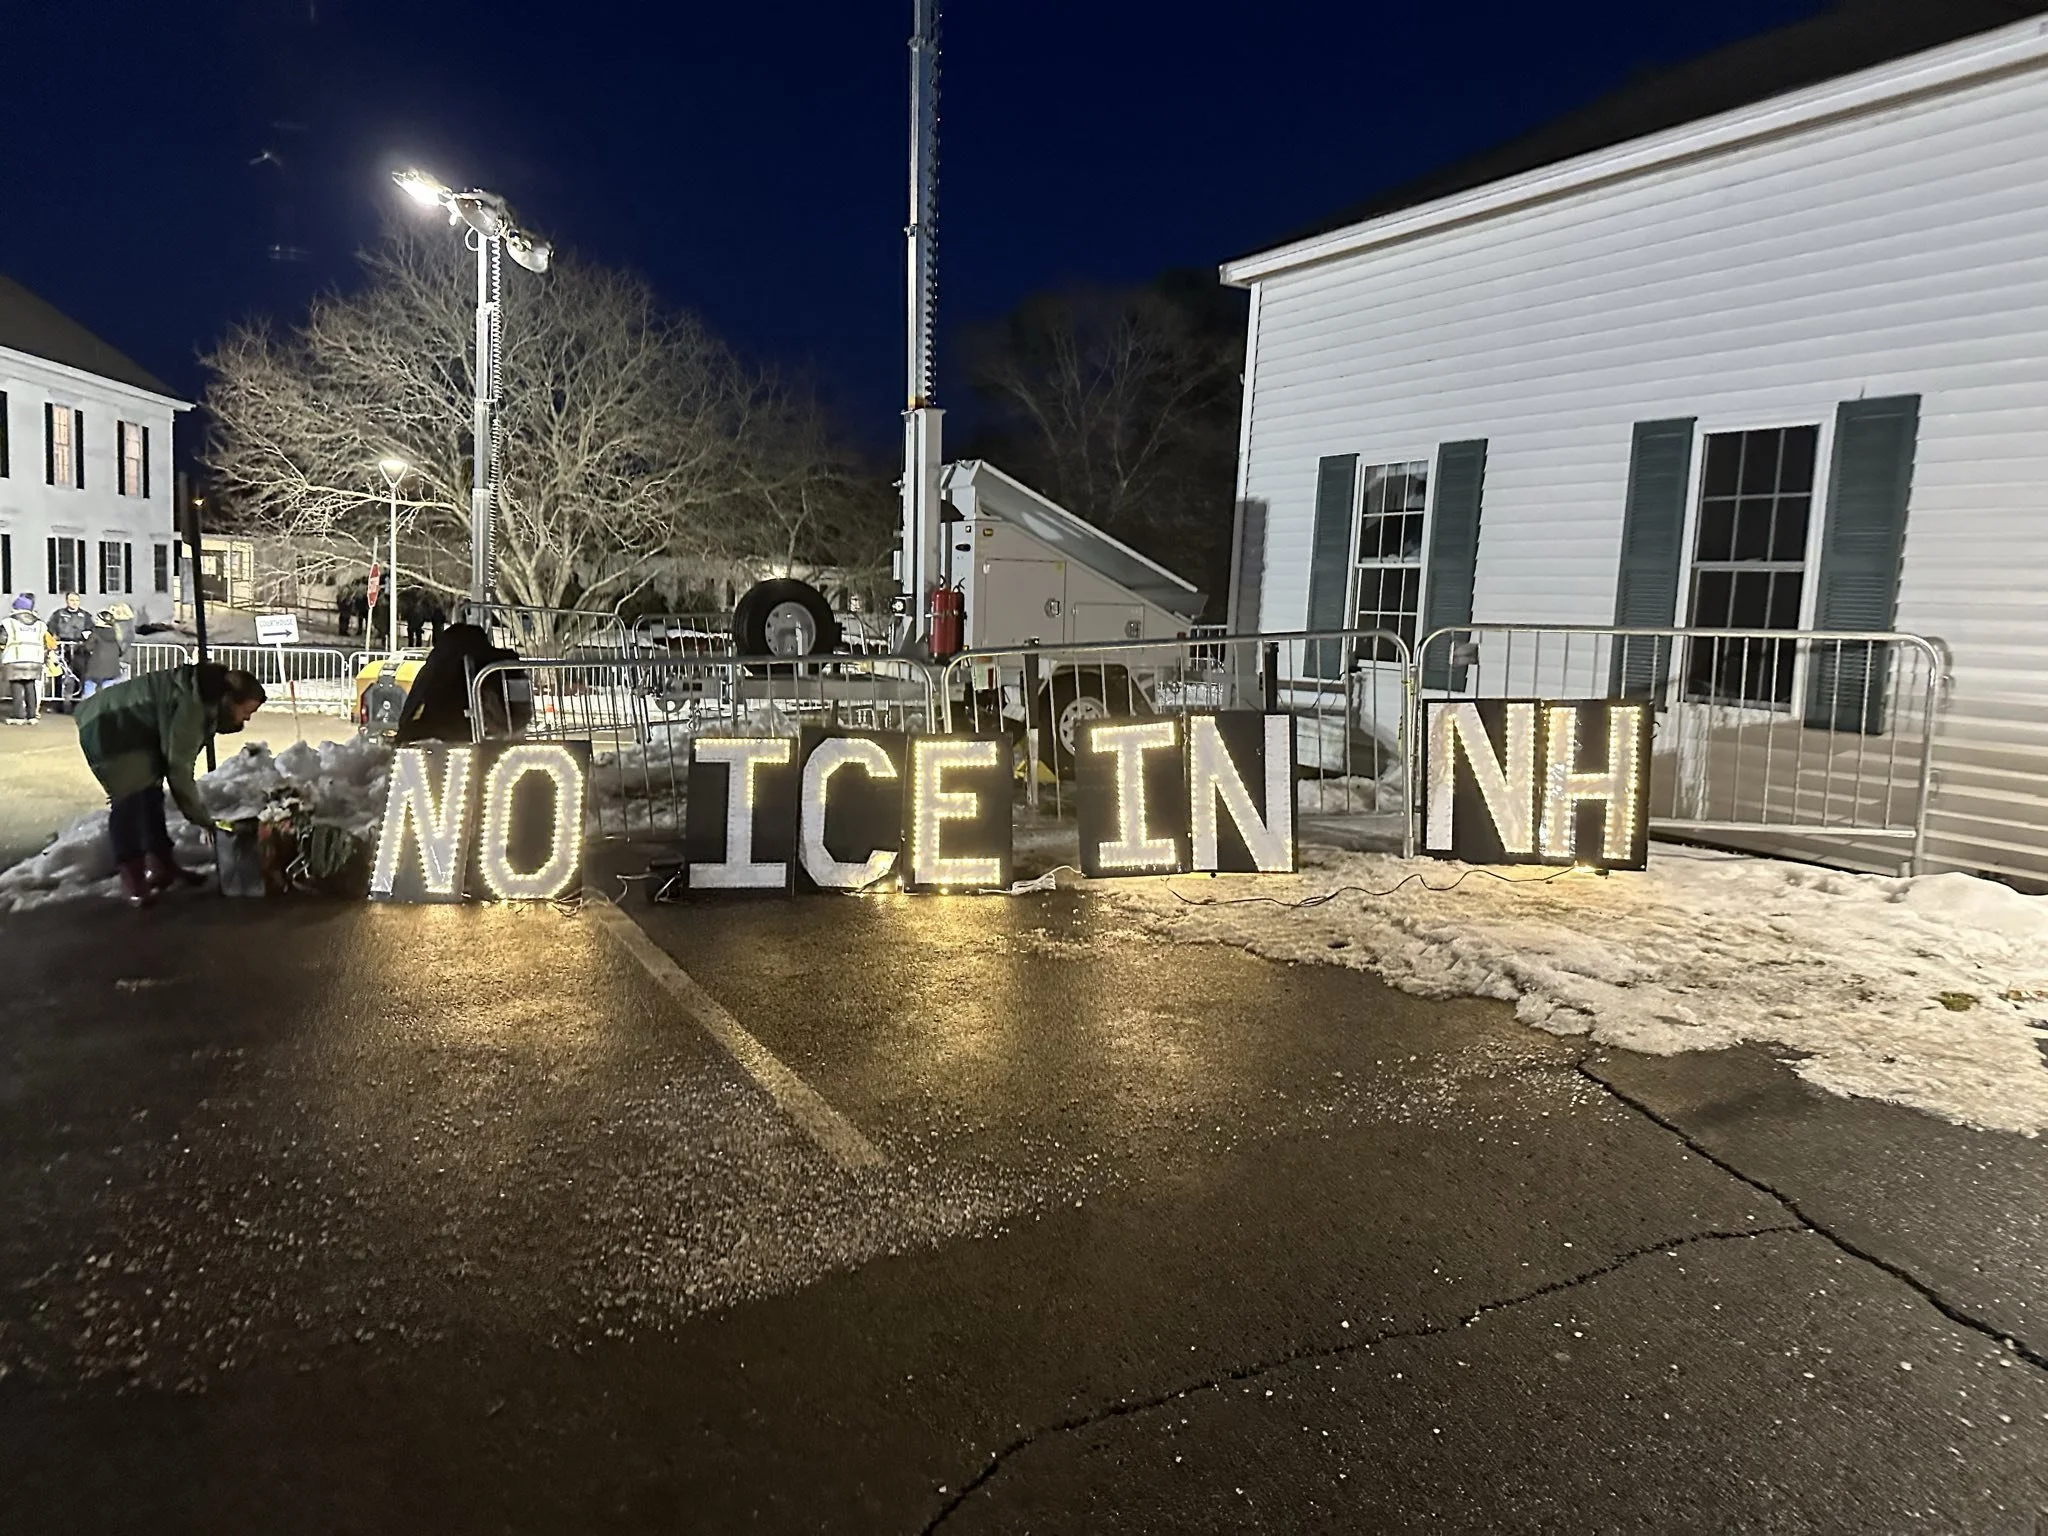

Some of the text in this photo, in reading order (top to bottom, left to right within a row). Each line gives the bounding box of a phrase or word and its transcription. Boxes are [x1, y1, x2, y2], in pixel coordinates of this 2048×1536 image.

[369, 702, 1642, 900] NO ICE IN NH
